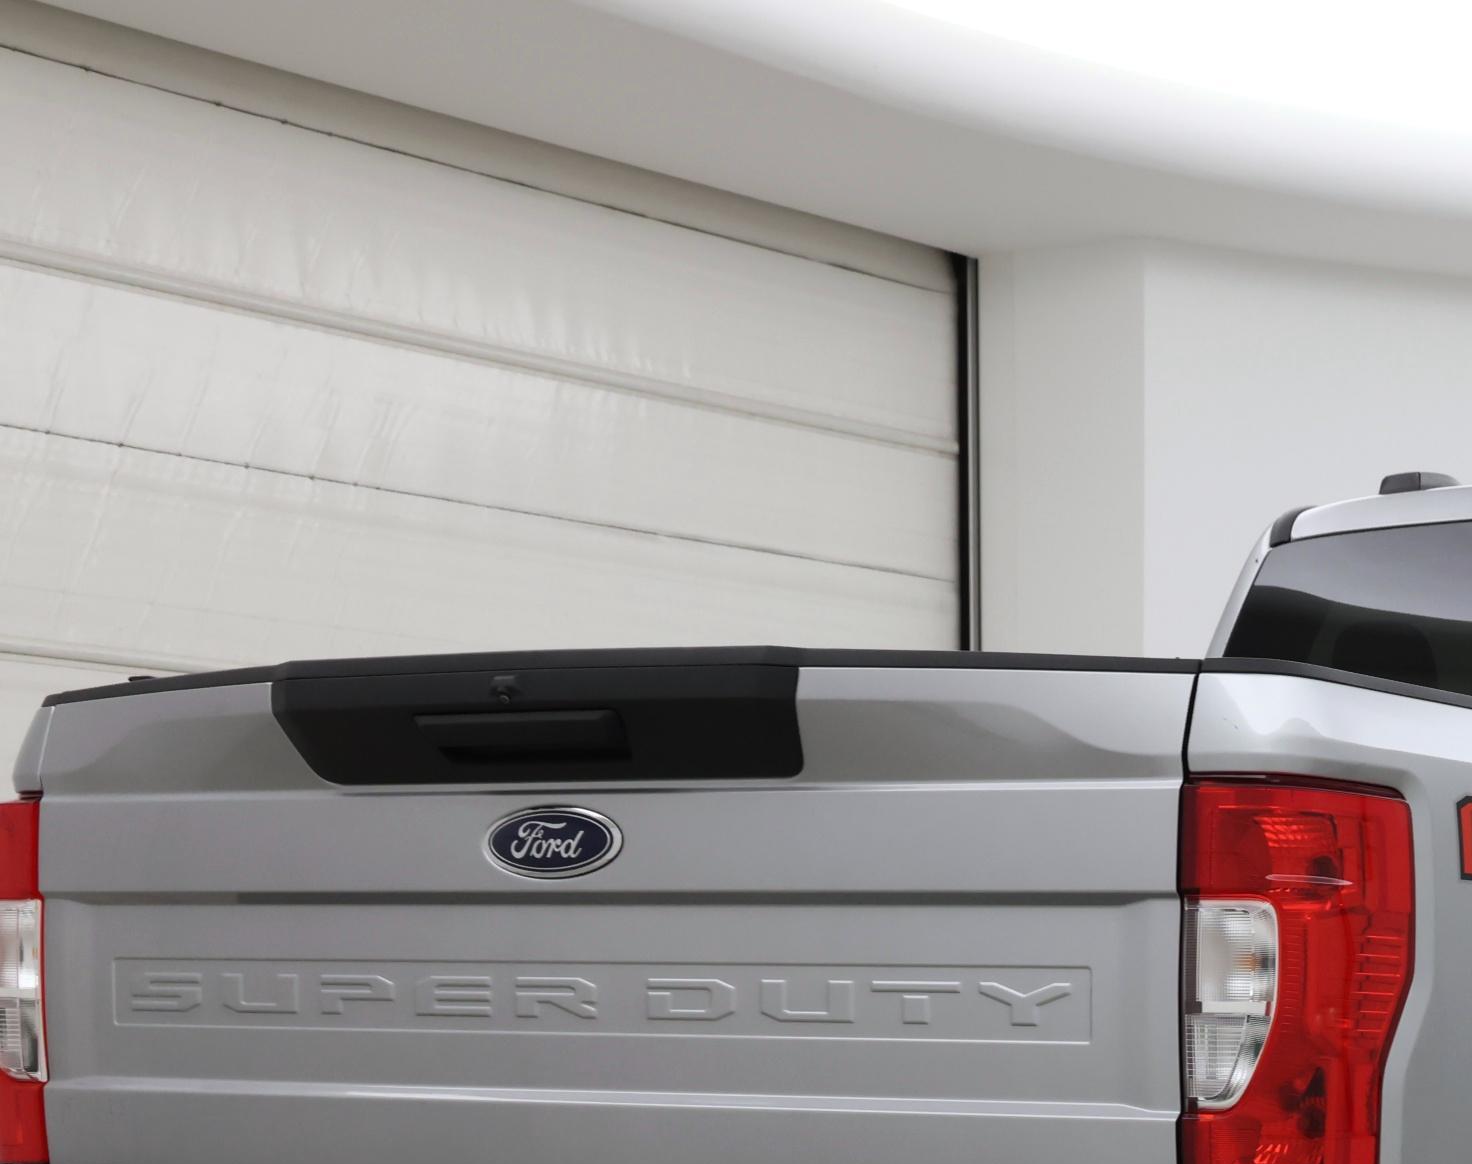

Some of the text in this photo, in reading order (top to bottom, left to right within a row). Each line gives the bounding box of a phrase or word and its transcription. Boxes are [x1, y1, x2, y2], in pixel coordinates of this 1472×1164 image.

[510, 820, 585, 859] Ford
[130, 971, 1073, 1027] SUPER DUTY
